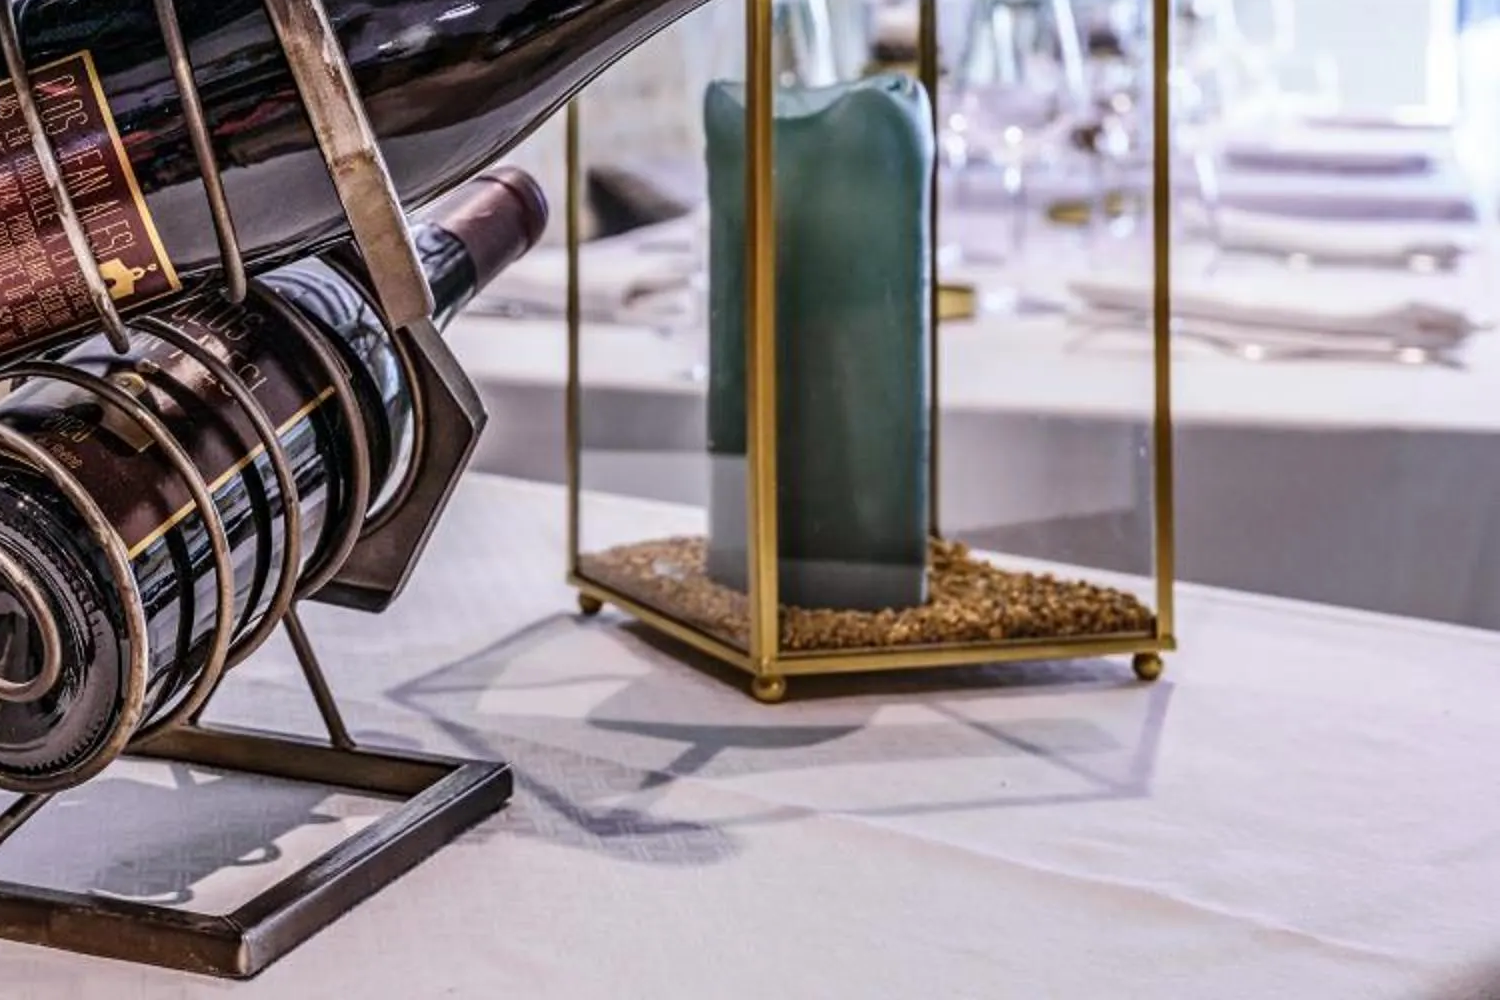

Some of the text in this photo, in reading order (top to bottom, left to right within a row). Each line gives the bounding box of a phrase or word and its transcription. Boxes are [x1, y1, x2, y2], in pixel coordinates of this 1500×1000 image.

[29, 72, 137, 260] CLOS JEAN ALESI
